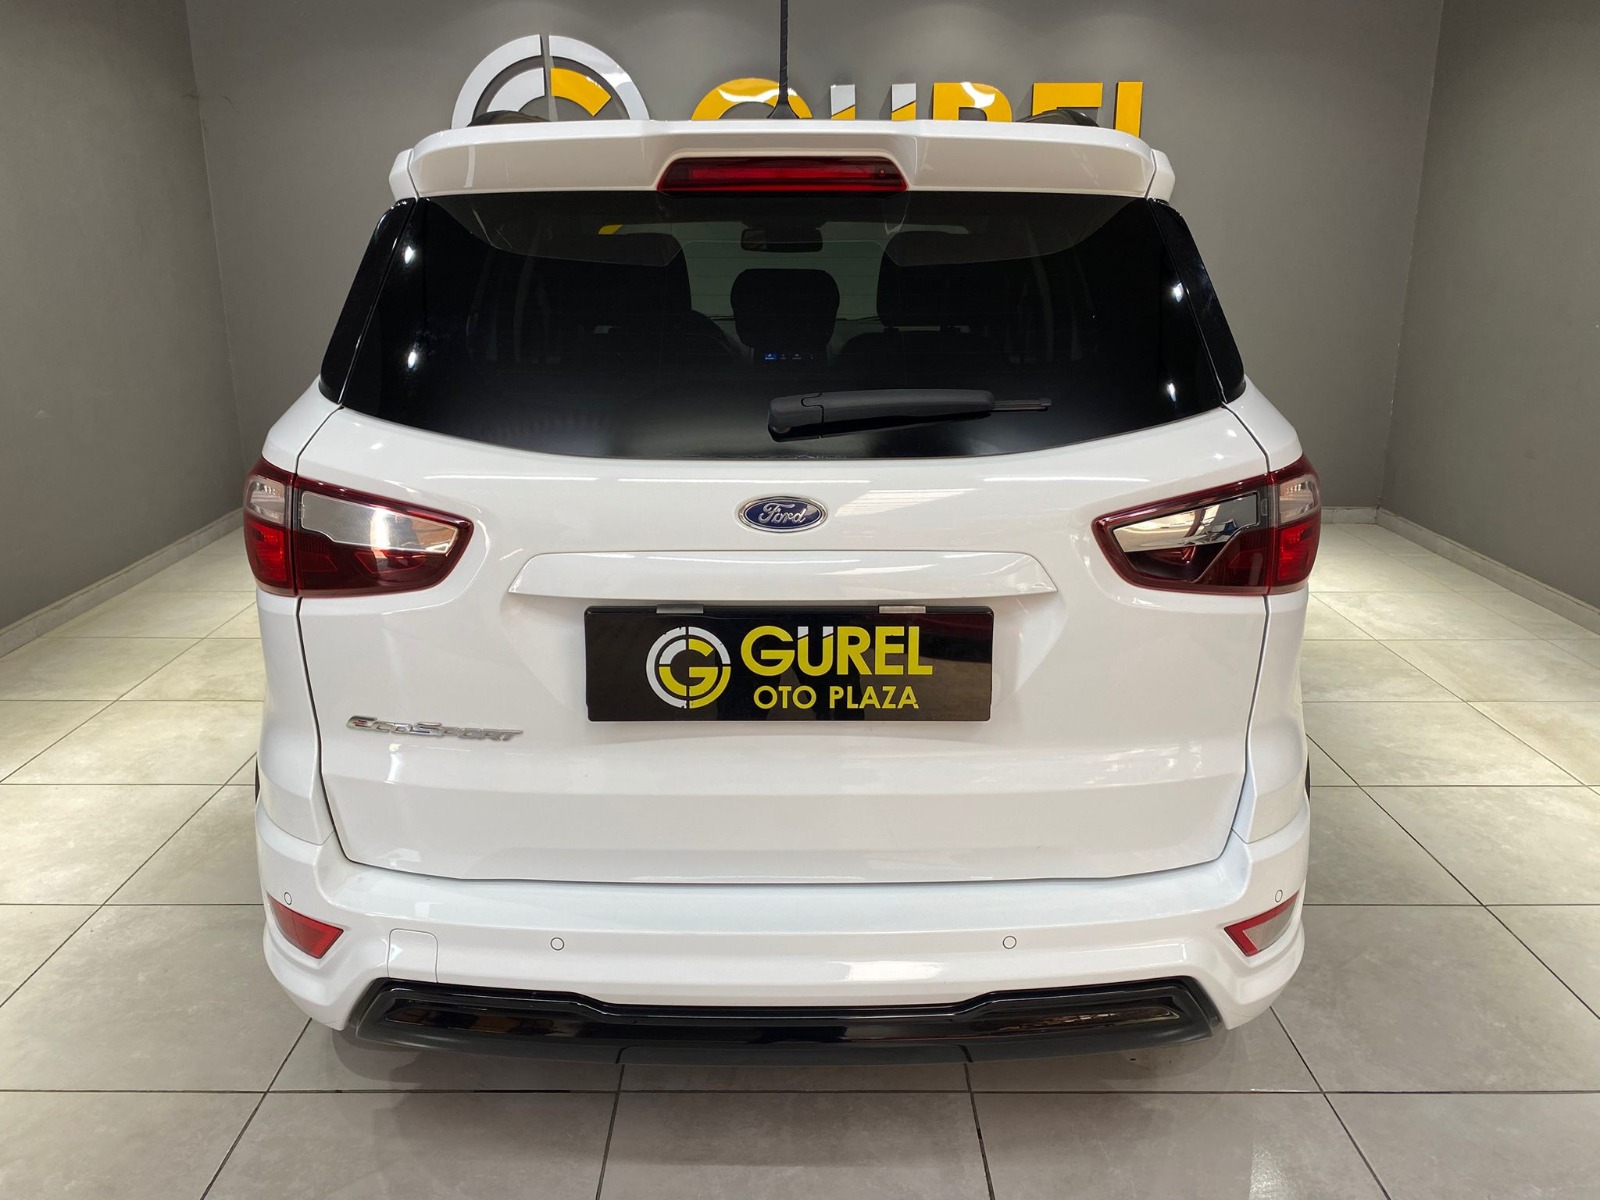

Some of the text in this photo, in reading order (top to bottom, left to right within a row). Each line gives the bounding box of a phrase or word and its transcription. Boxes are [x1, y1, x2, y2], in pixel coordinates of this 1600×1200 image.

[758, 503, 806, 524] Ford
[753, 685, 919, 709] OTO PLAZA
